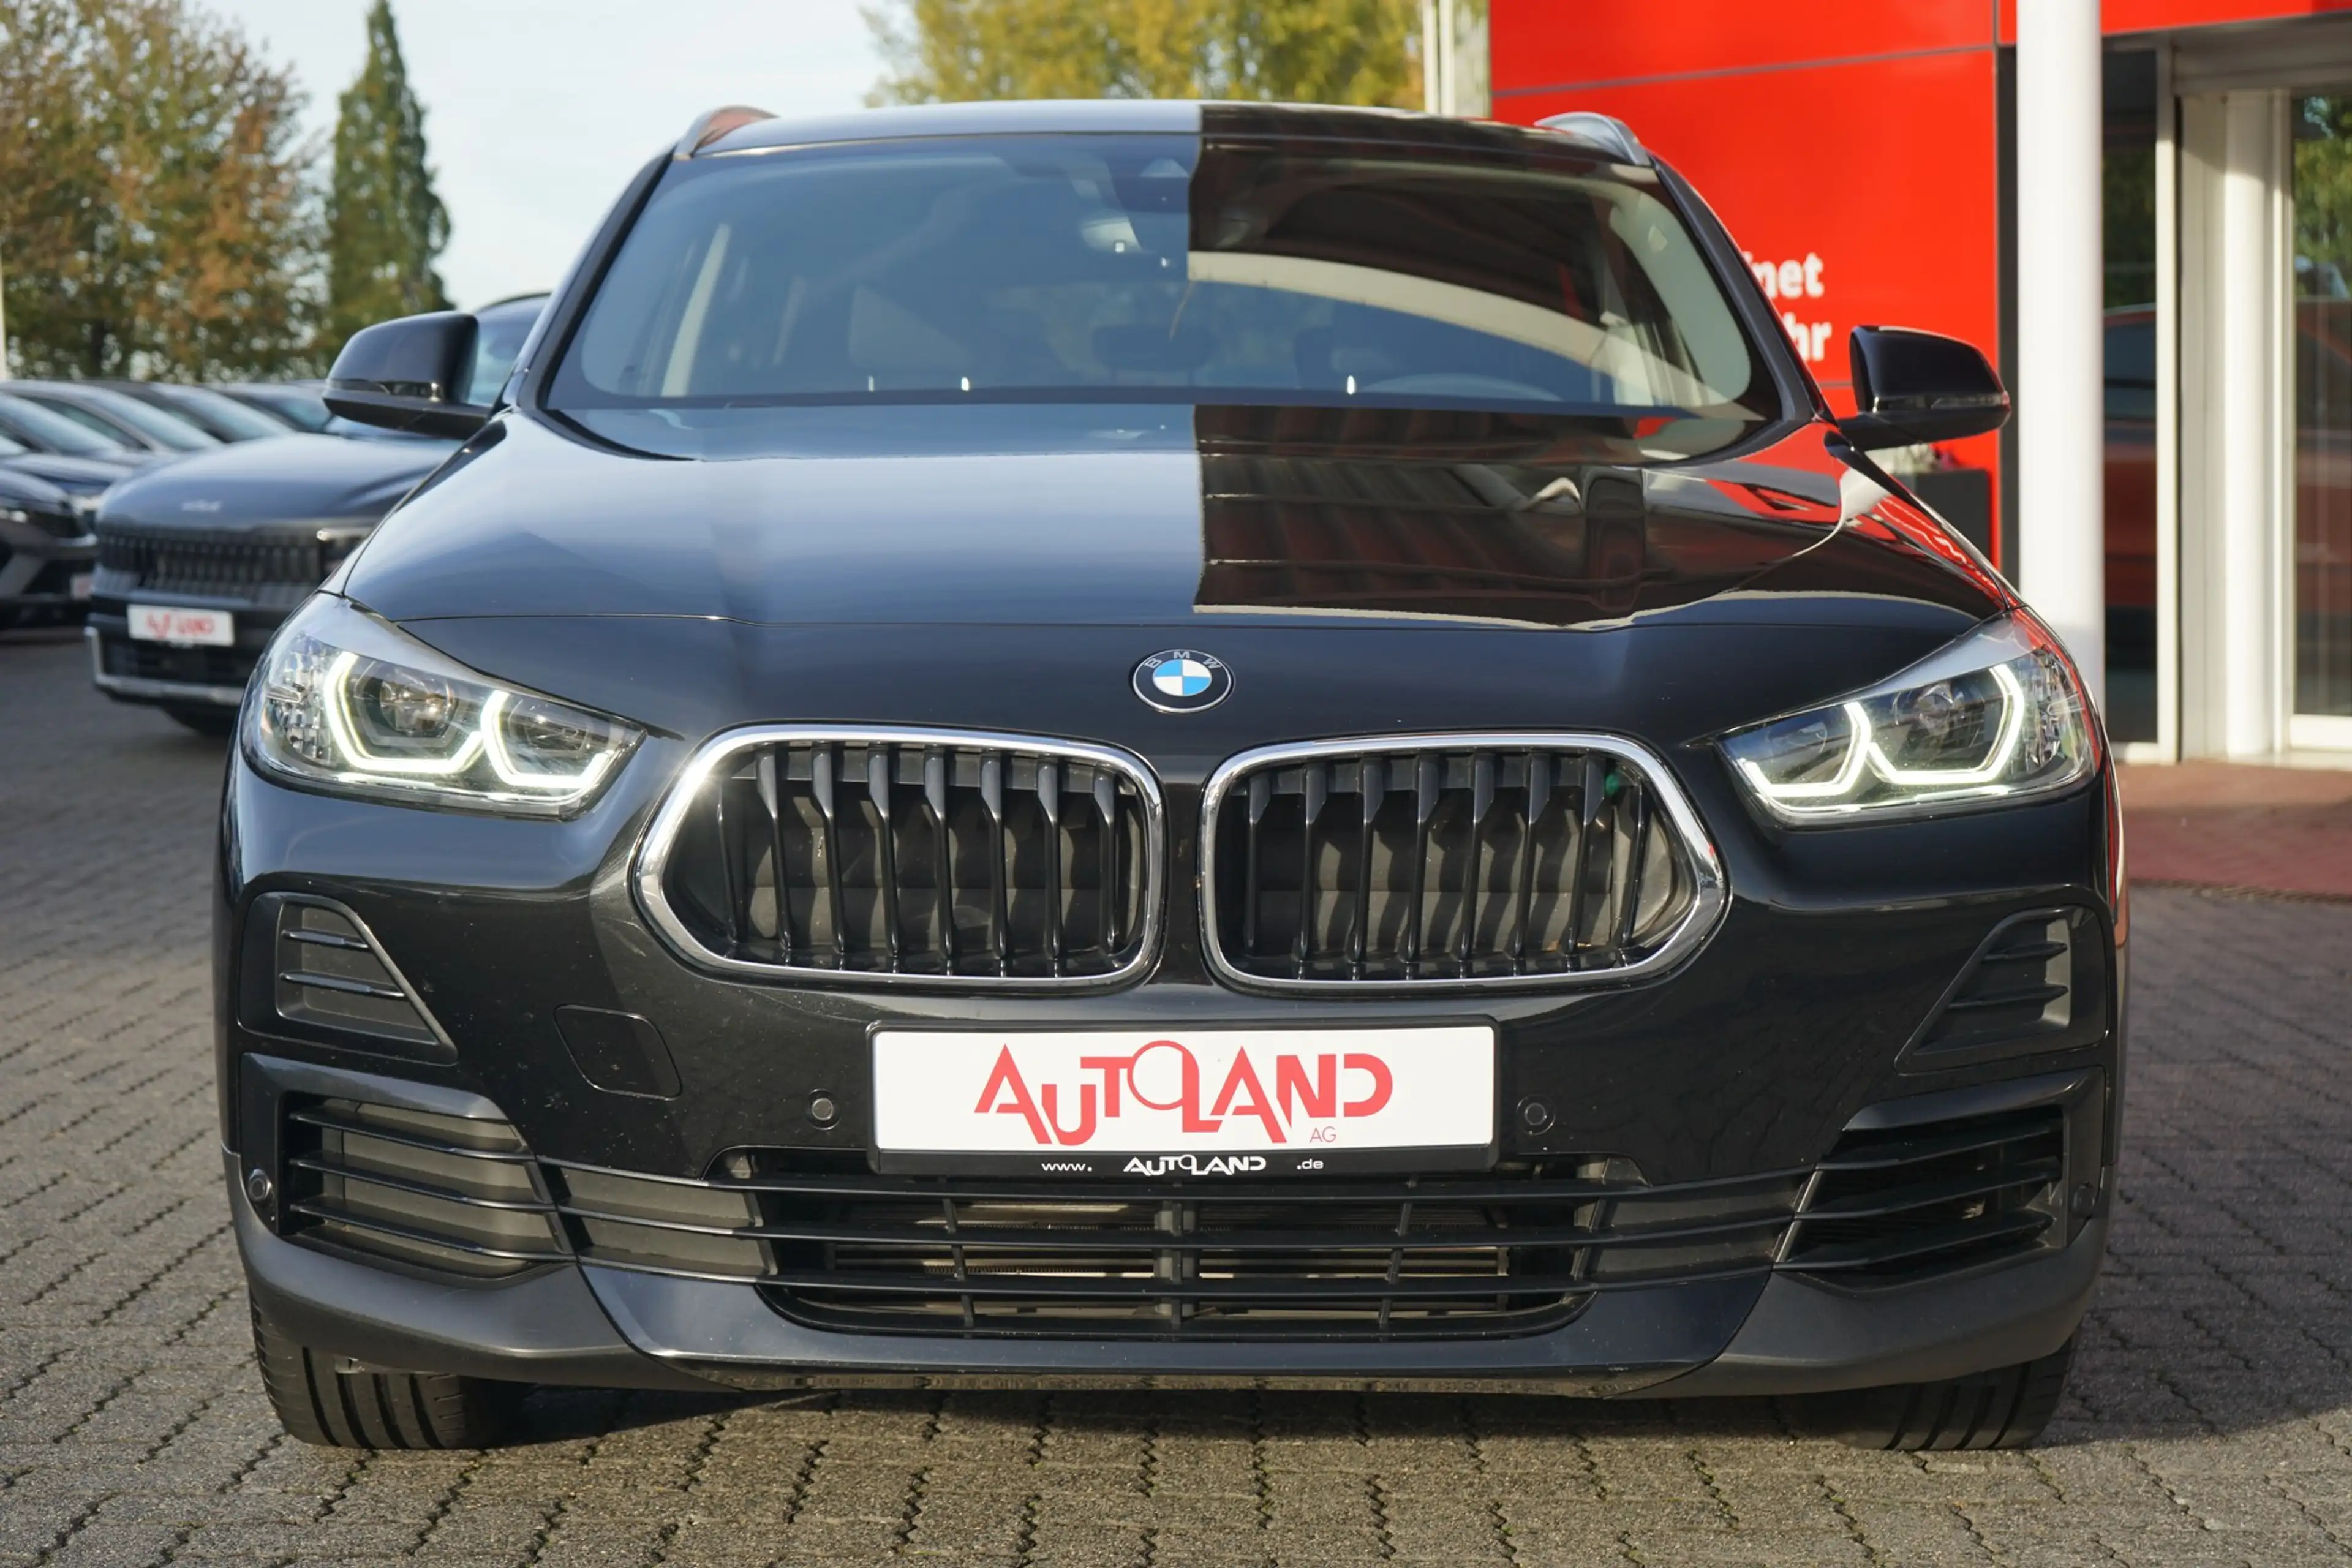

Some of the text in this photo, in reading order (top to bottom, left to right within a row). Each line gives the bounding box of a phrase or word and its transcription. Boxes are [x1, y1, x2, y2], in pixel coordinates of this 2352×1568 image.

[1144, 650, 1221, 669] BMW
[974, 1039, 1393, 1147] AUTOLAND
[1310, 1127, 1336, 1144] AG
[1041, 1153, 1324, 1177] www. AUTOLAND .de
